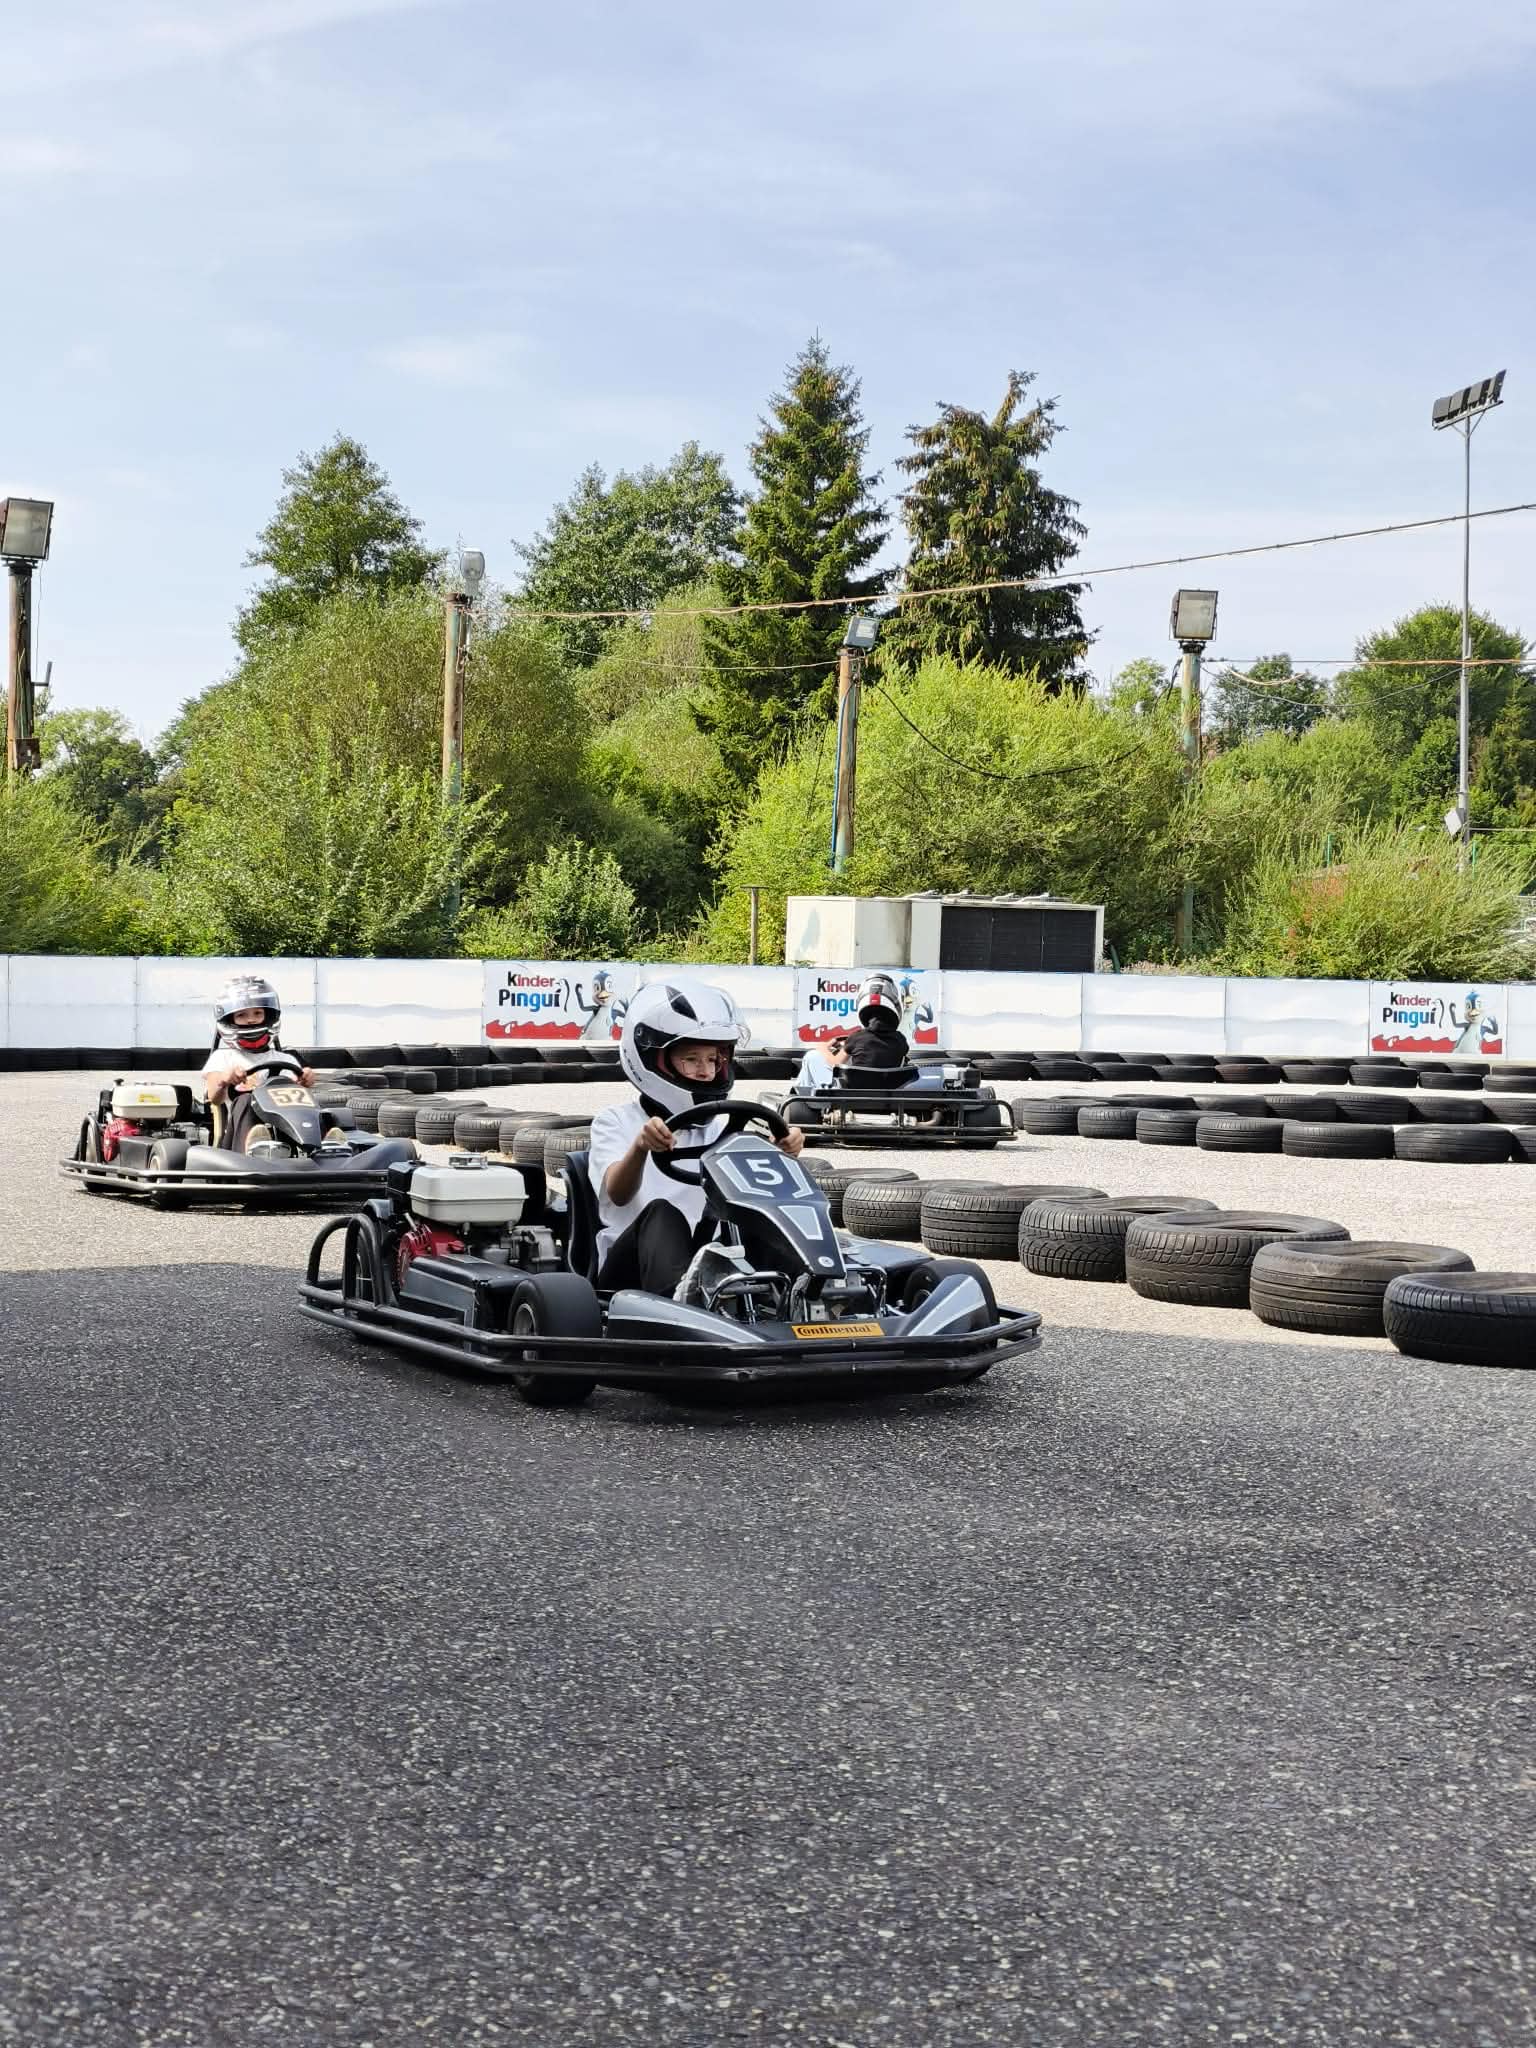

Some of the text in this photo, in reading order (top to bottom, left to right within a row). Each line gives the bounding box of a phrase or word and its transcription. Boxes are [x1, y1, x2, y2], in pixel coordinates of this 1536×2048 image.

[809, 994, 858, 1017] Pingu
[272, 1089, 313, 1104] 52
[745, 1158, 784, 1185] 5
[797, 1324, 873, 1336] Continental
